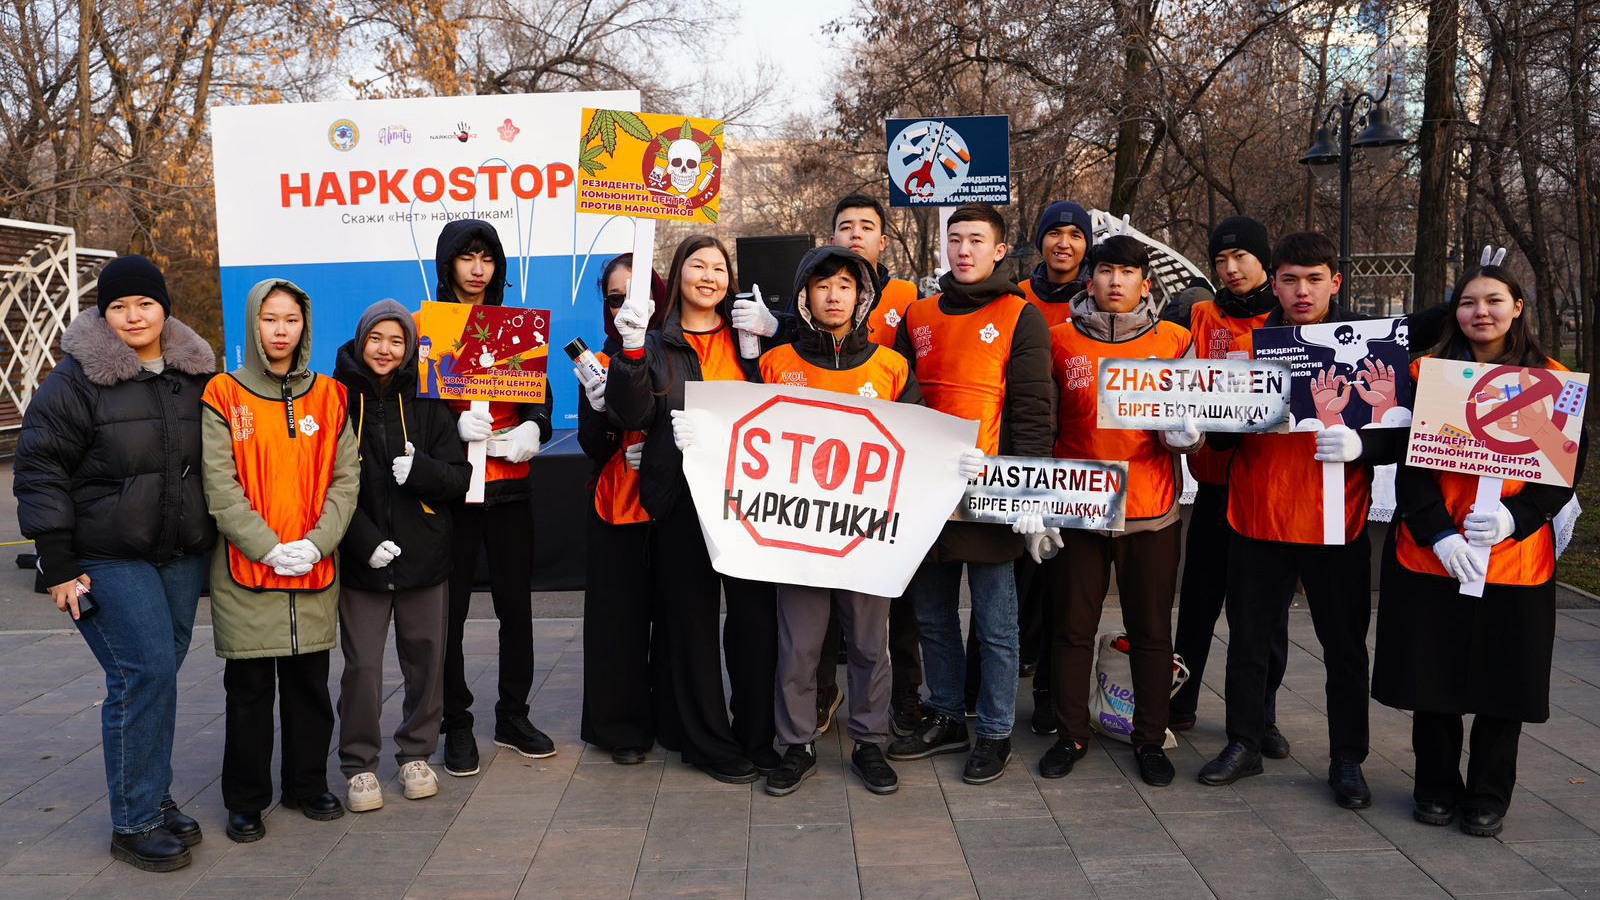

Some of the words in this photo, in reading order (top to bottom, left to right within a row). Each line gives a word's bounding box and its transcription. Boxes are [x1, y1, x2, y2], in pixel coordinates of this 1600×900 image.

[582, 179, 645, 191] РЕЗИДЕНТЫ
[971, 184, 1008, 193] ЦЕНТРА
[581, 190, 649, 202] КОМЬЮНИТИ
[651, 195, 693, 207] ЦЕНТРА
[946, 194, 1008, 203] НАРКОТИКОВ
[341, 212, 385, 225] Скажи
[388, 211, 427, 223] «Нет»
[431, 208, 514, 222] наркотикам!
[580, 201, 622, 211] ПРОТИВ
[624, 204, 694, 217] НАРКОТИКОВ
[1210, 328, 1232, 340] VOL
[1256, 347, 1305, 355] РЕЗИДЕНТЫ
[1065, 355, 1092, 369] VOL
[1290, 361, 1323, 369] ПРОТИВ
[487, 369, 544, 378] РЕЗИДЕНТЫ
[1105, 367, 1284, 395] ZHASTARMEN
[443, 376, 504, 387] КОМЬЮНИТИ
[506, 379, 543, 388] ЦЕНТРА
[440, 386, 478, 395] ПРОТИВ
[480, 388, 542, 398] НАРКОТИКОВ
[286, 396, 295, 429] FASHION
[1118, 402, 1161, 418] БІРГЕ
[1413, 432, 1486, 448] РЕЗИДЕНТЫ
[740, 427, 890, 495] STOP
[1411, 443, 1489, 460] КОМЬЮНИТИ
[1491, 454, 1541, 468] ЦЕНТРА
[1410, 455, 1457, 469] ПРОТИВ
[1459, 462, 1542, 480] НАРКОТИКОВ
[967, 464, 1121, 494] HASTARMEN
[968, 496, 1008, 512] БІРГЕ
[722, 488, 900, 545] НАРКОТИКИ!
